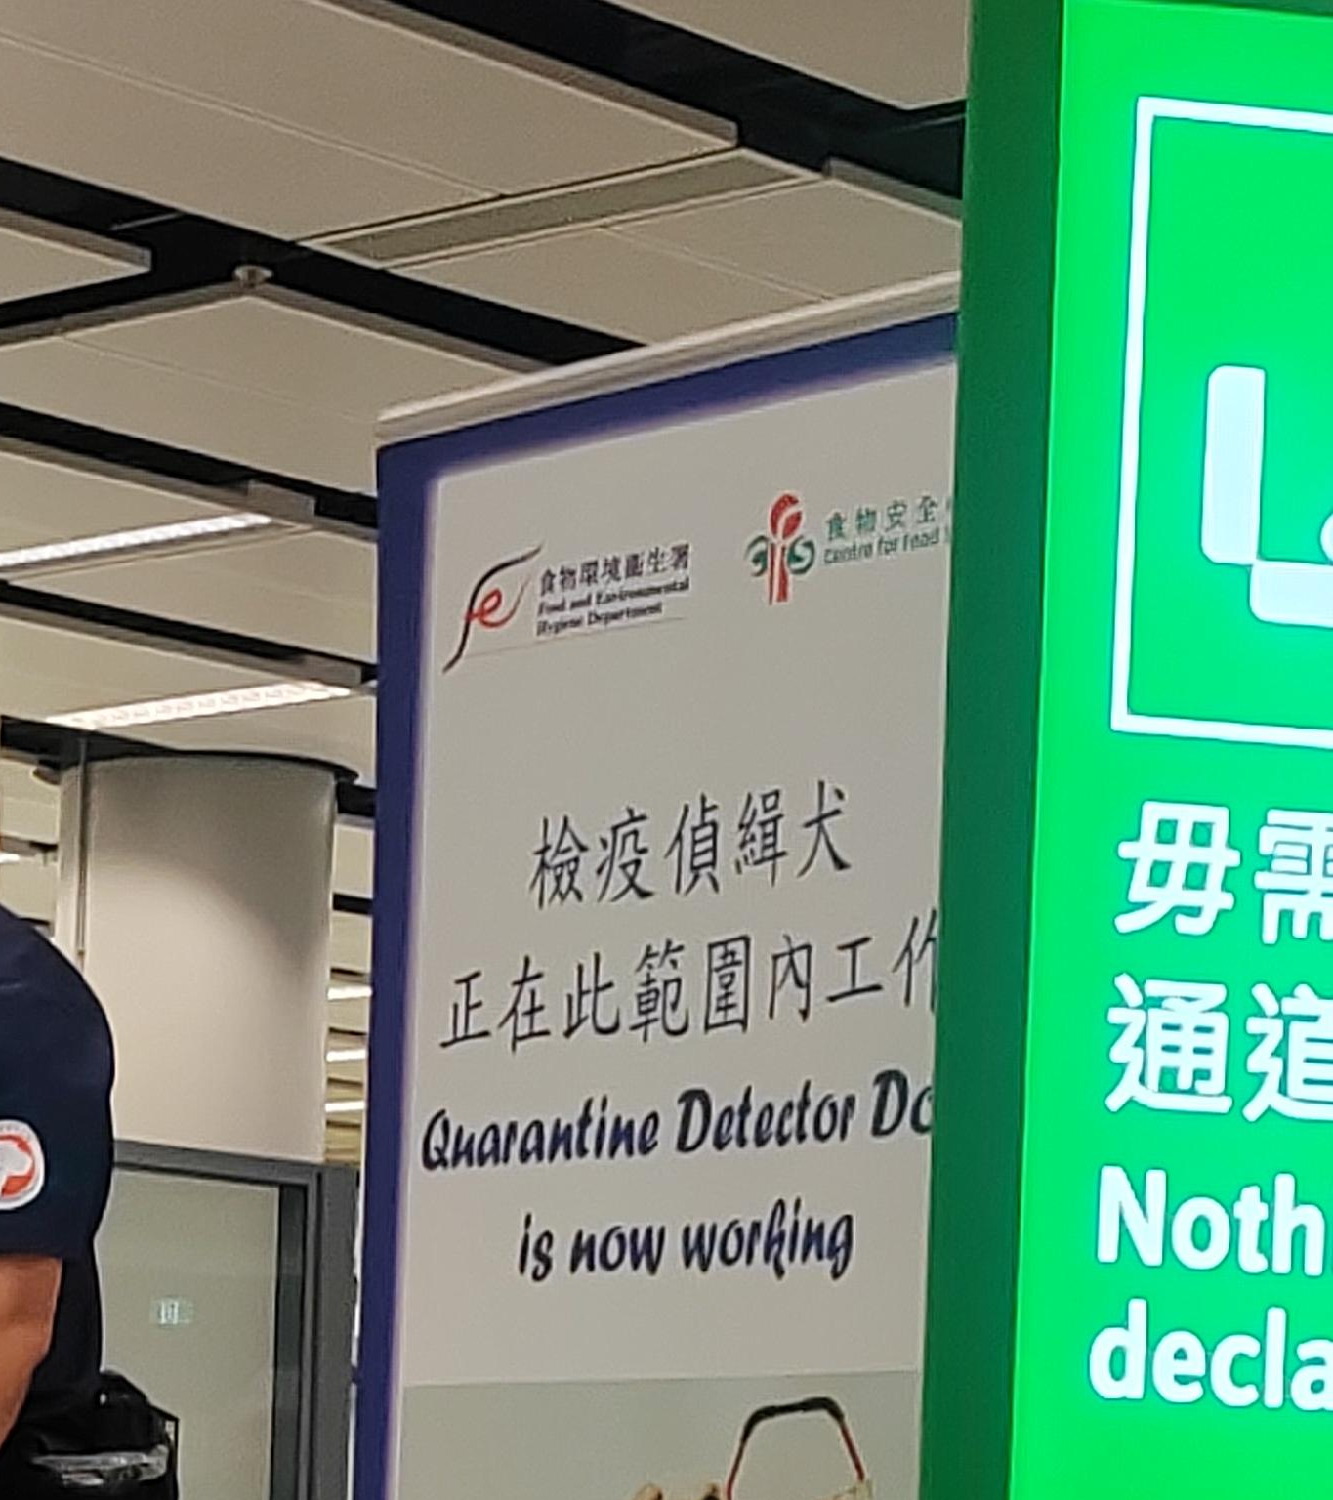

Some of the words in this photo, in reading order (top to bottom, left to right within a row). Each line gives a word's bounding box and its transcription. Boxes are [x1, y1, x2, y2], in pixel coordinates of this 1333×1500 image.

[529, 780, 852, 909] 檢疫偵緝犬
[1113, 800, 1333, 945] 毋需
[1104, 972, 1333, 1123] 通道
[421, 1095, 659, 1172] Quarantine
[676, 1080, 855, 1153] Detector
[519, 1213, 554, 1282] is
[569, 1224, 666, 1276] now
[682, 1197, 854, 1281] working
[1096, 1164, 1326, 1278] Noth
